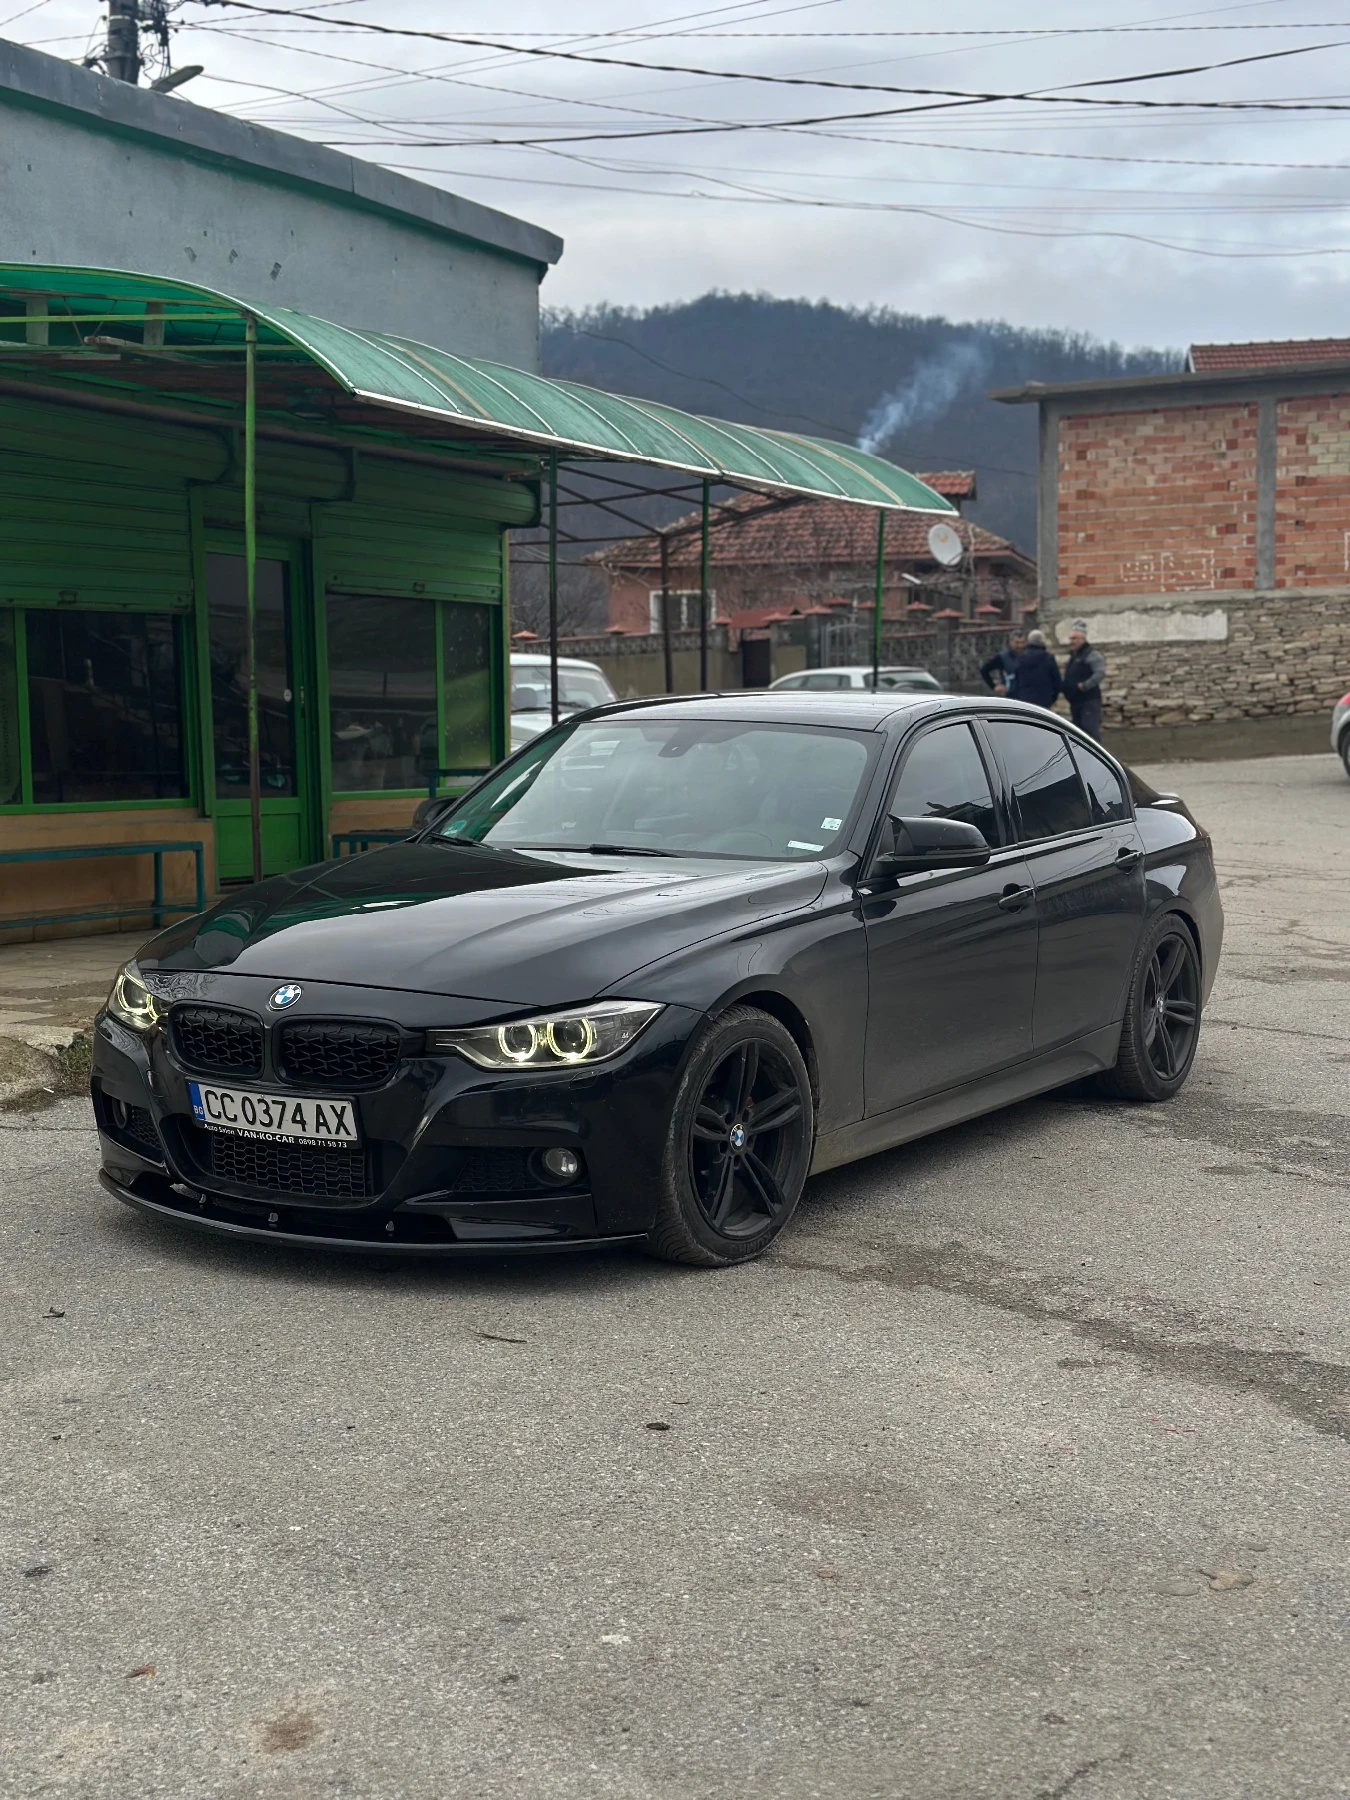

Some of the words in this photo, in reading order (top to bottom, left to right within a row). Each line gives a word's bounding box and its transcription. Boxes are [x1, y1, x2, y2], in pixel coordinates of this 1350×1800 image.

[193, 1105, 204, 1115] BG
[205, 1090, 238, 1123] CC
[241, 1096, 306, 1132] 0374
[316, 1104, 352, 1136] AX
[237, 1129, 295, 1144] VAN-KO-CAR
